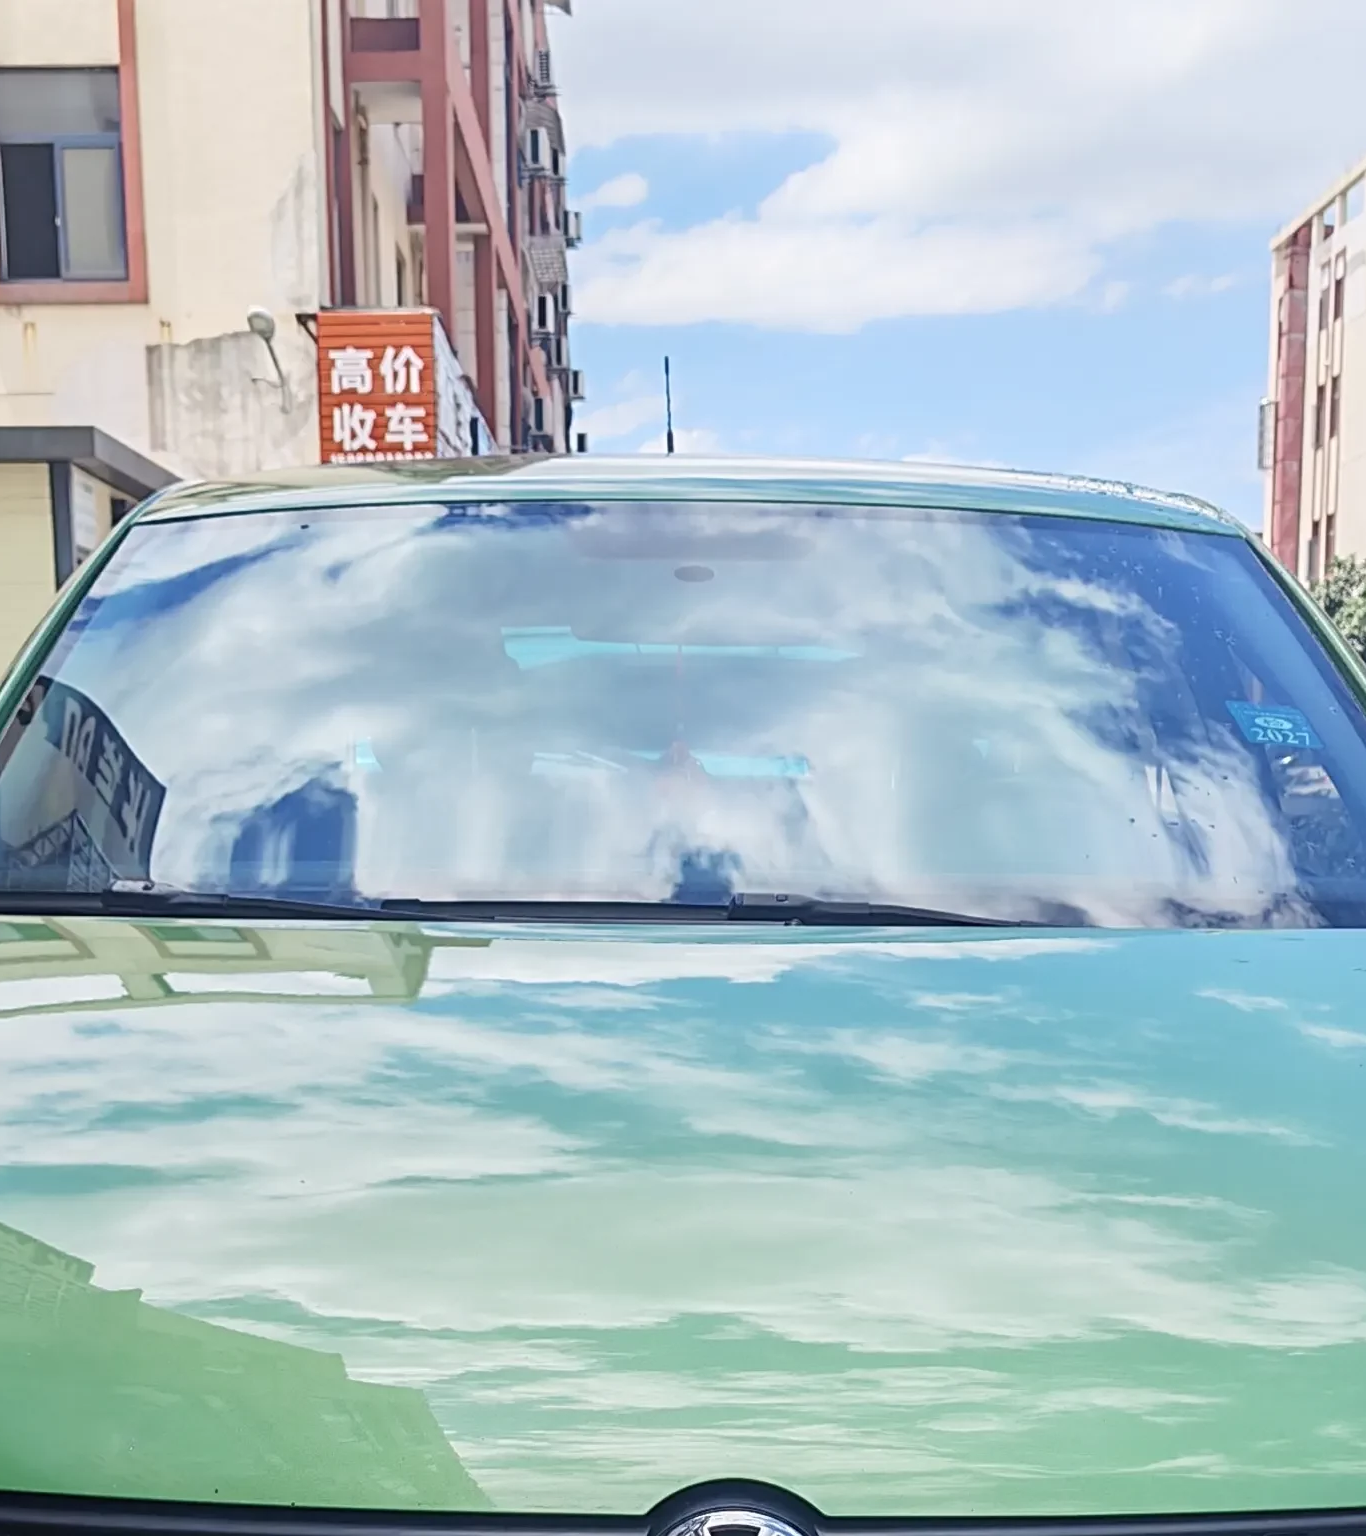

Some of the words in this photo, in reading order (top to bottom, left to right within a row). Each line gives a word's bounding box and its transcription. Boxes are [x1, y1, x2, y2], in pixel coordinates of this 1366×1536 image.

[328, 345, 424, 394] 高价
[332, 403, 429, 451] 收车
[1250, 727, 1310, 746] 2027
